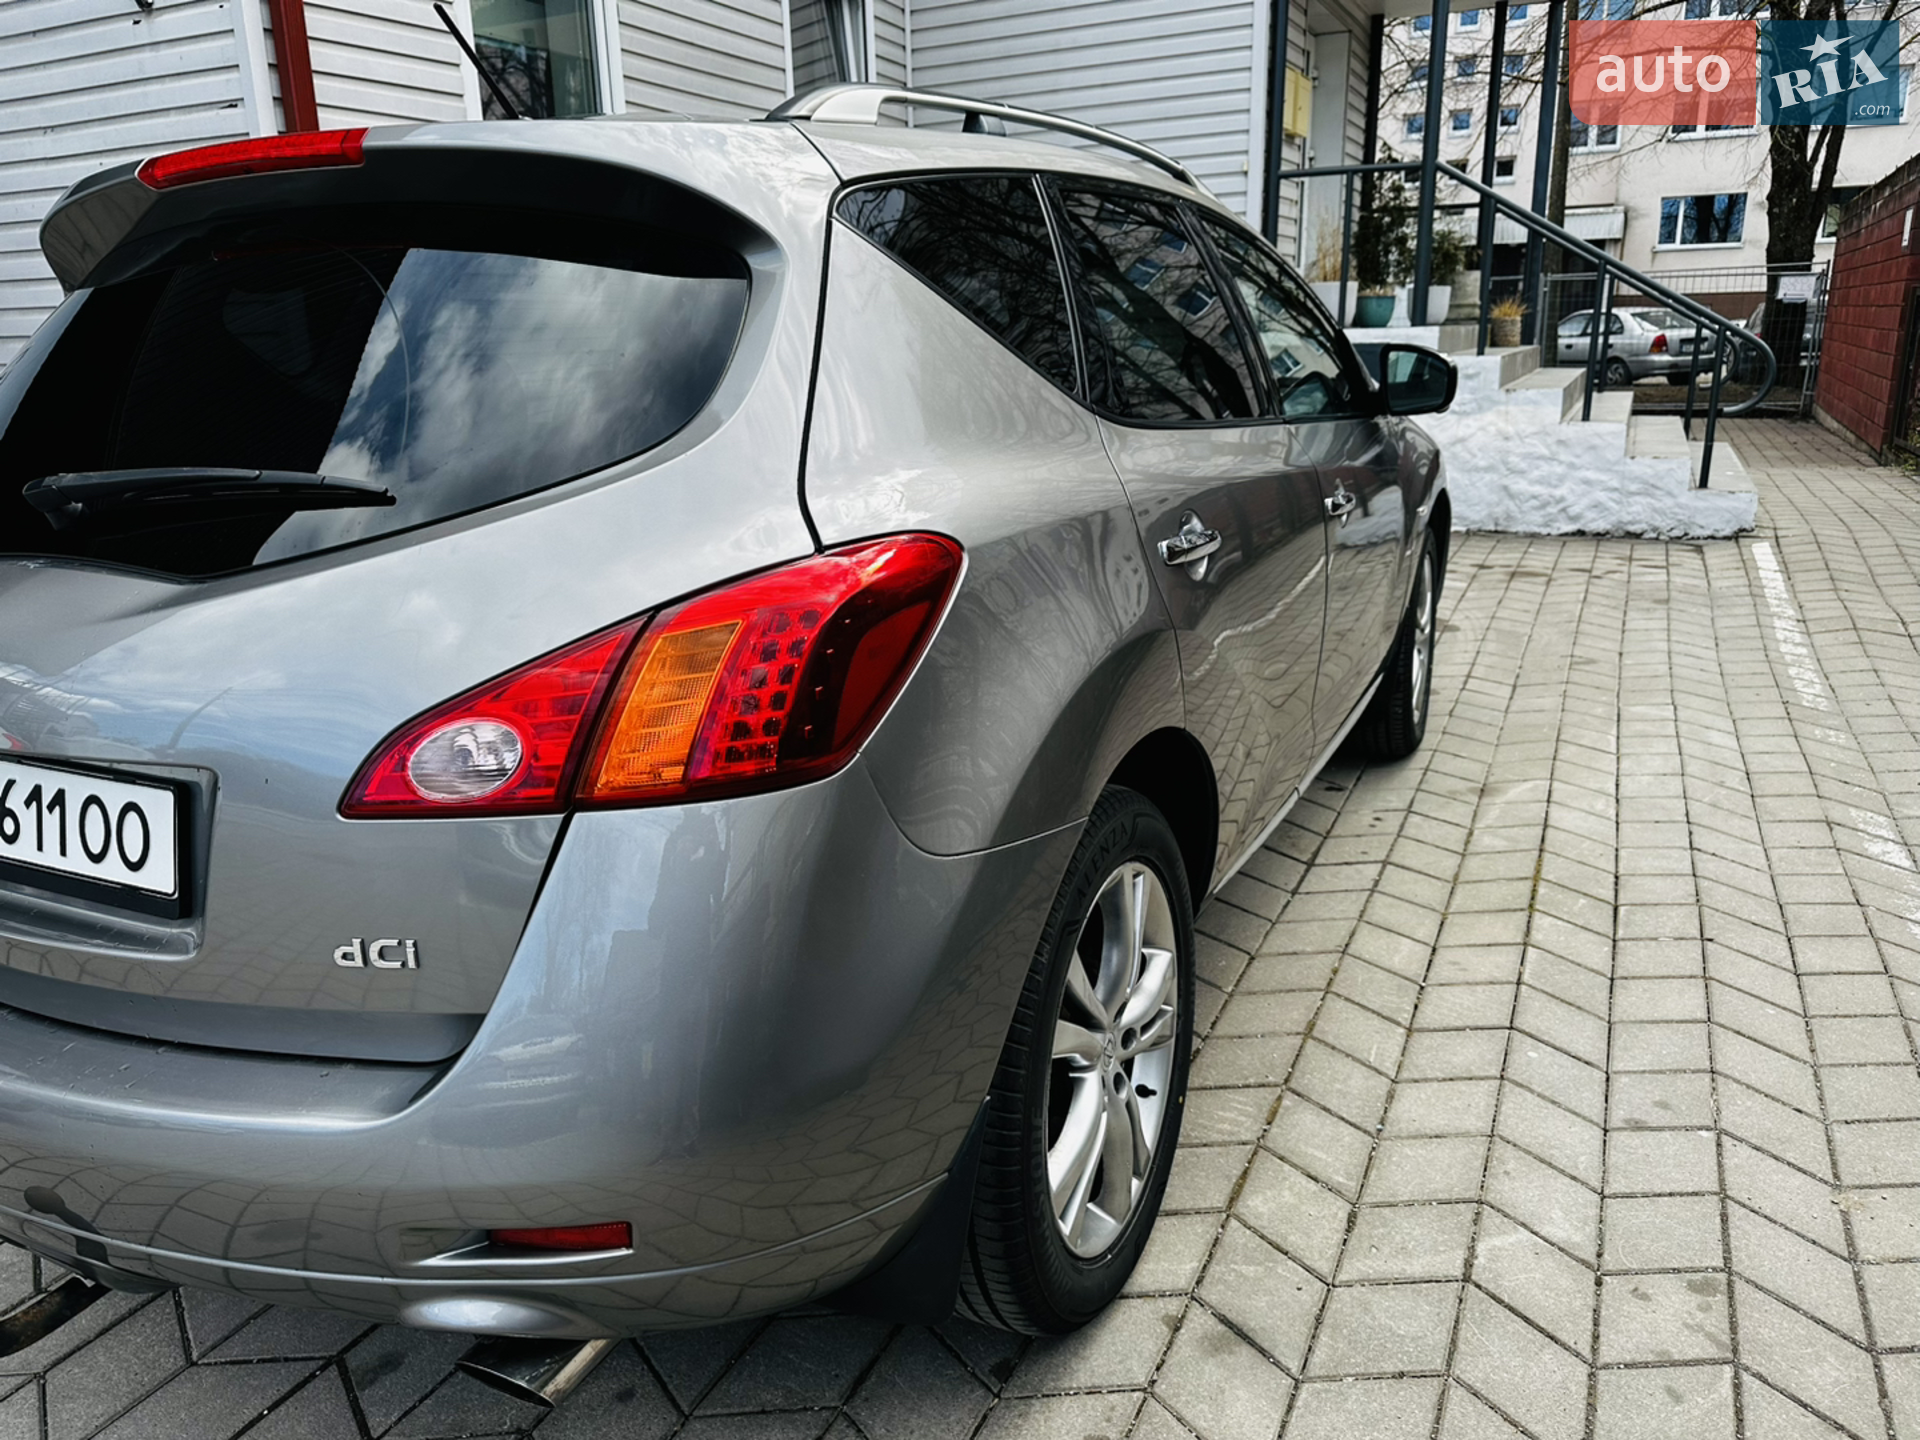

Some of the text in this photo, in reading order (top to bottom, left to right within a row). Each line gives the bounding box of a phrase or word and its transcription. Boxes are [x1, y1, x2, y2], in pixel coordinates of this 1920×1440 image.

[0, 778, 151, 872] 61100
[1076, 820, 1128, 909] ALENZA
[333, 938, 420, 969] dCi
